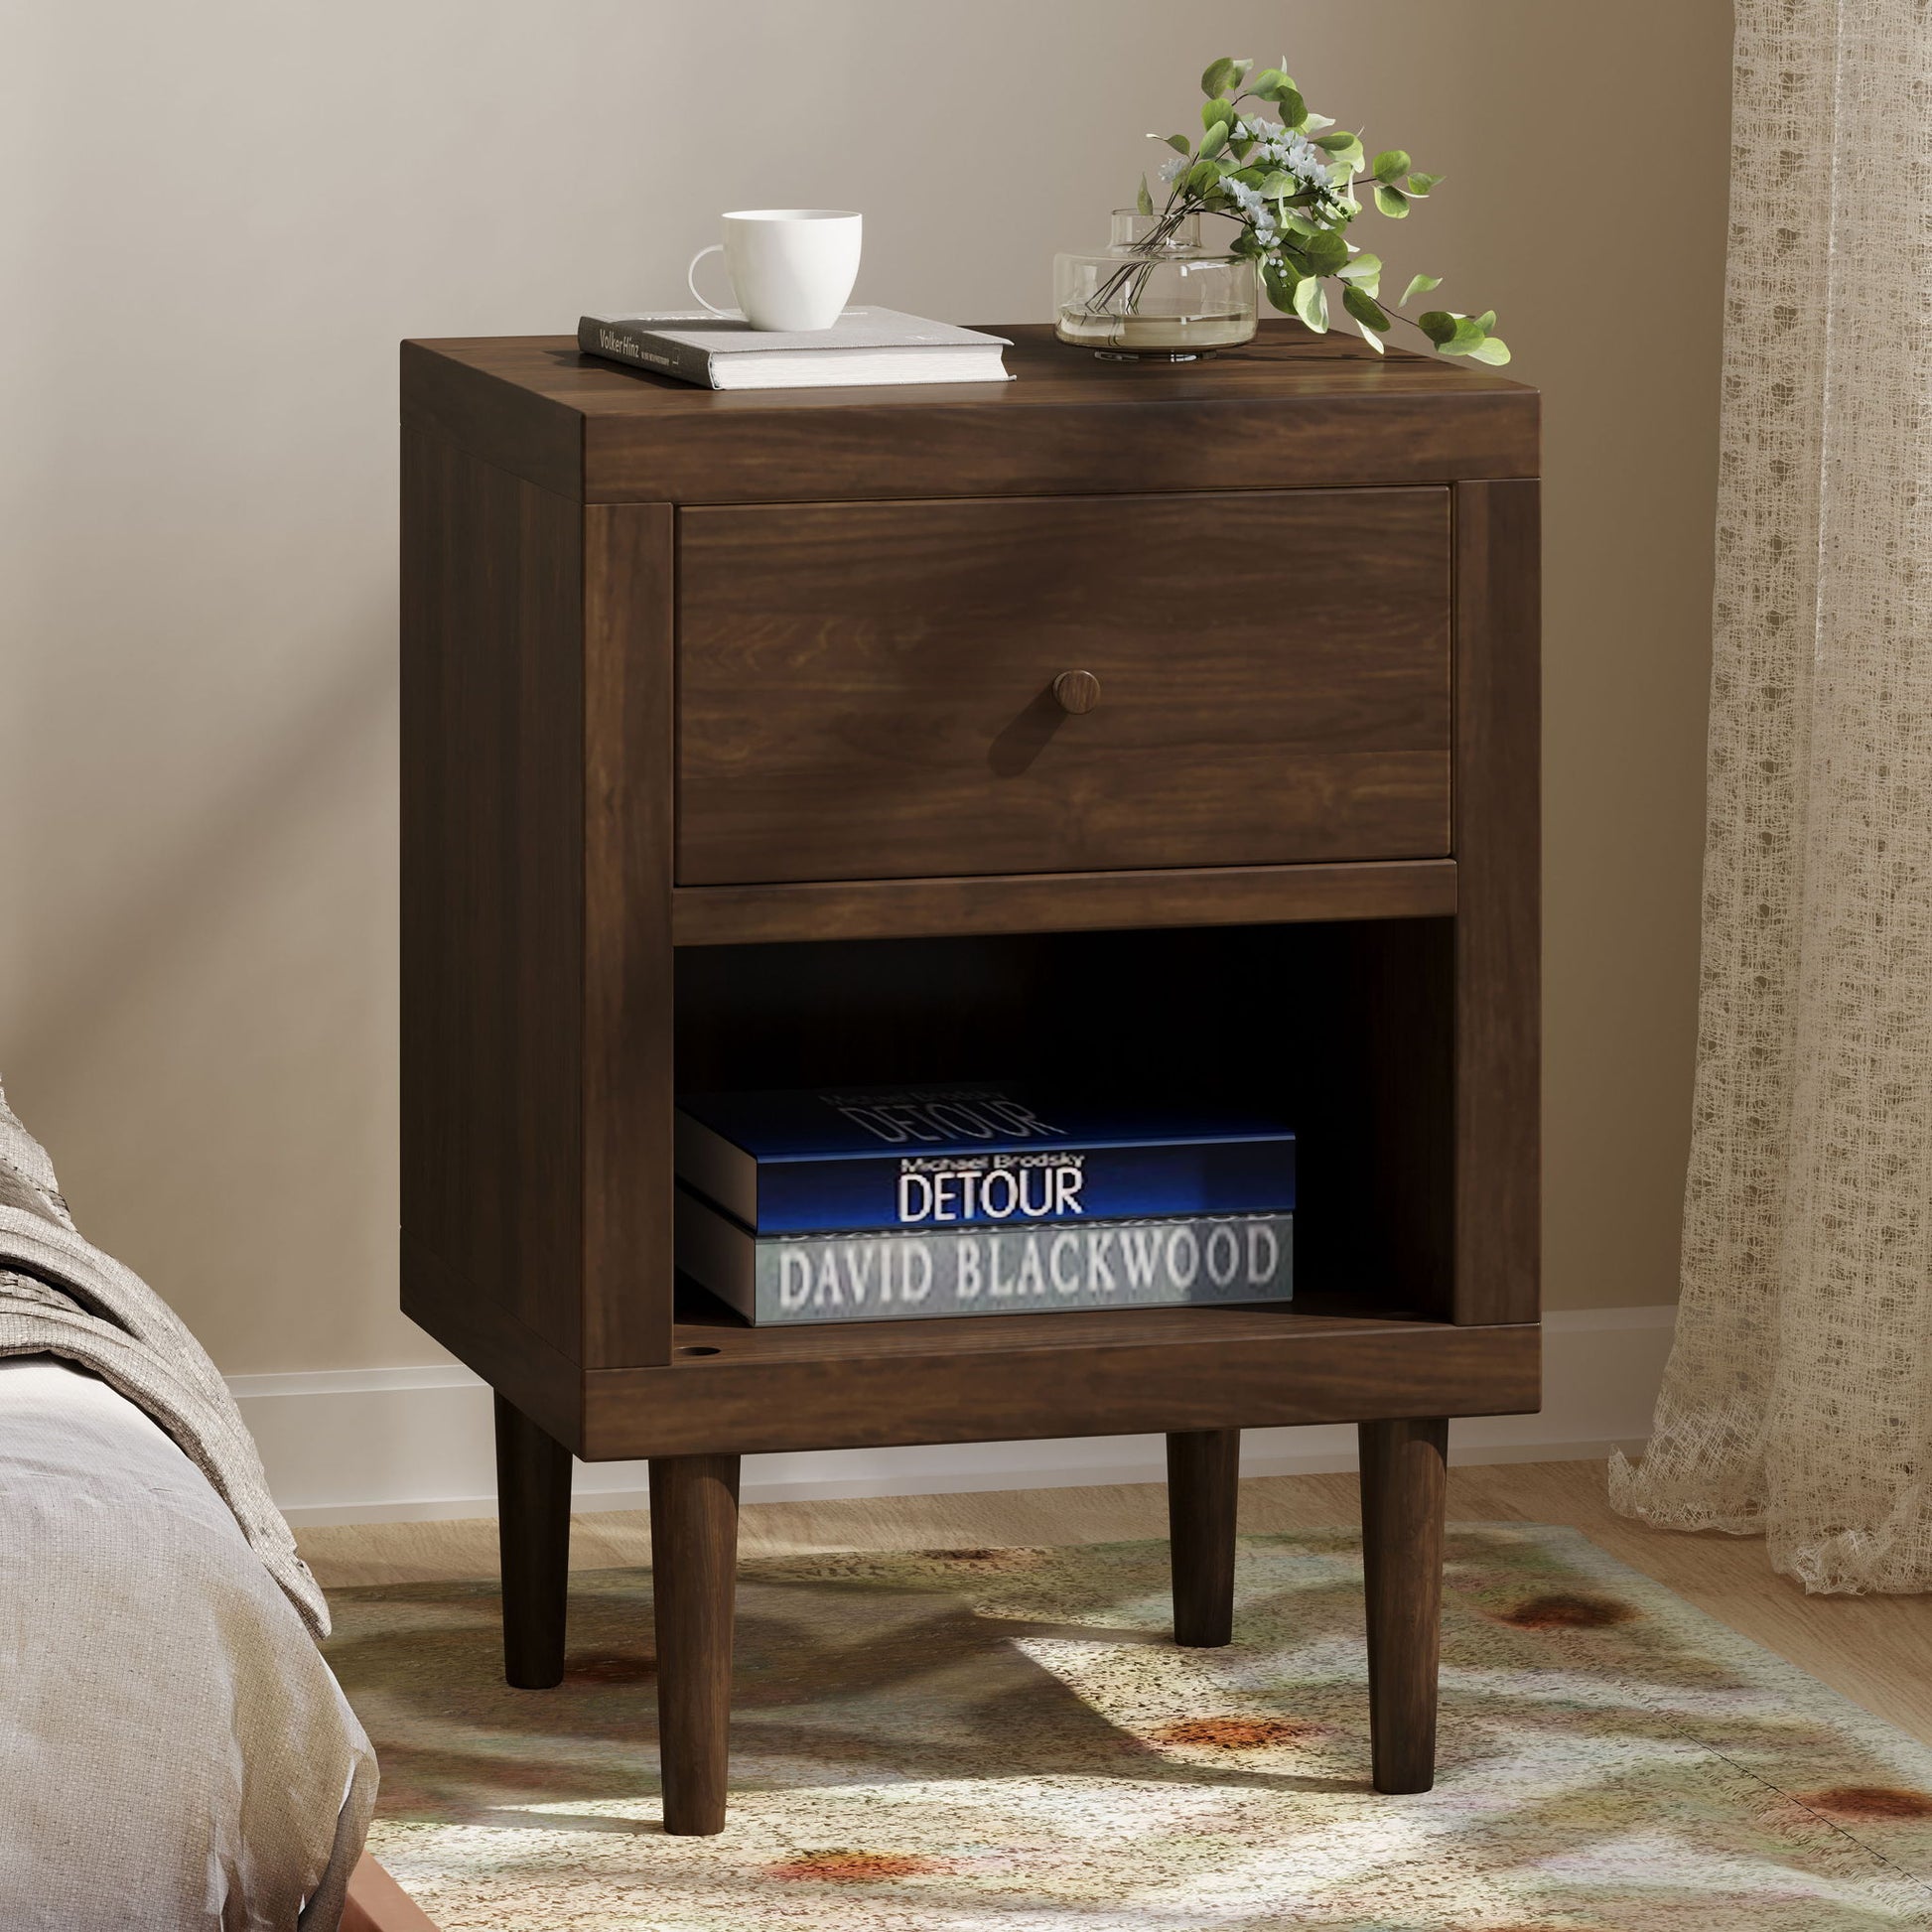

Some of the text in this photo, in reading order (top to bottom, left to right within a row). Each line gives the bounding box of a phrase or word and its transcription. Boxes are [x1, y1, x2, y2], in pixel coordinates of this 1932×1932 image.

[837, 1100, 1072, 1143] DETOUR
[993, 1152, 1085, 1169] Brodsky
[899, 1167, 1084, 1223] DETOUR
[779, 1224, 1281, 1309] DAVID BLACKWOOD
